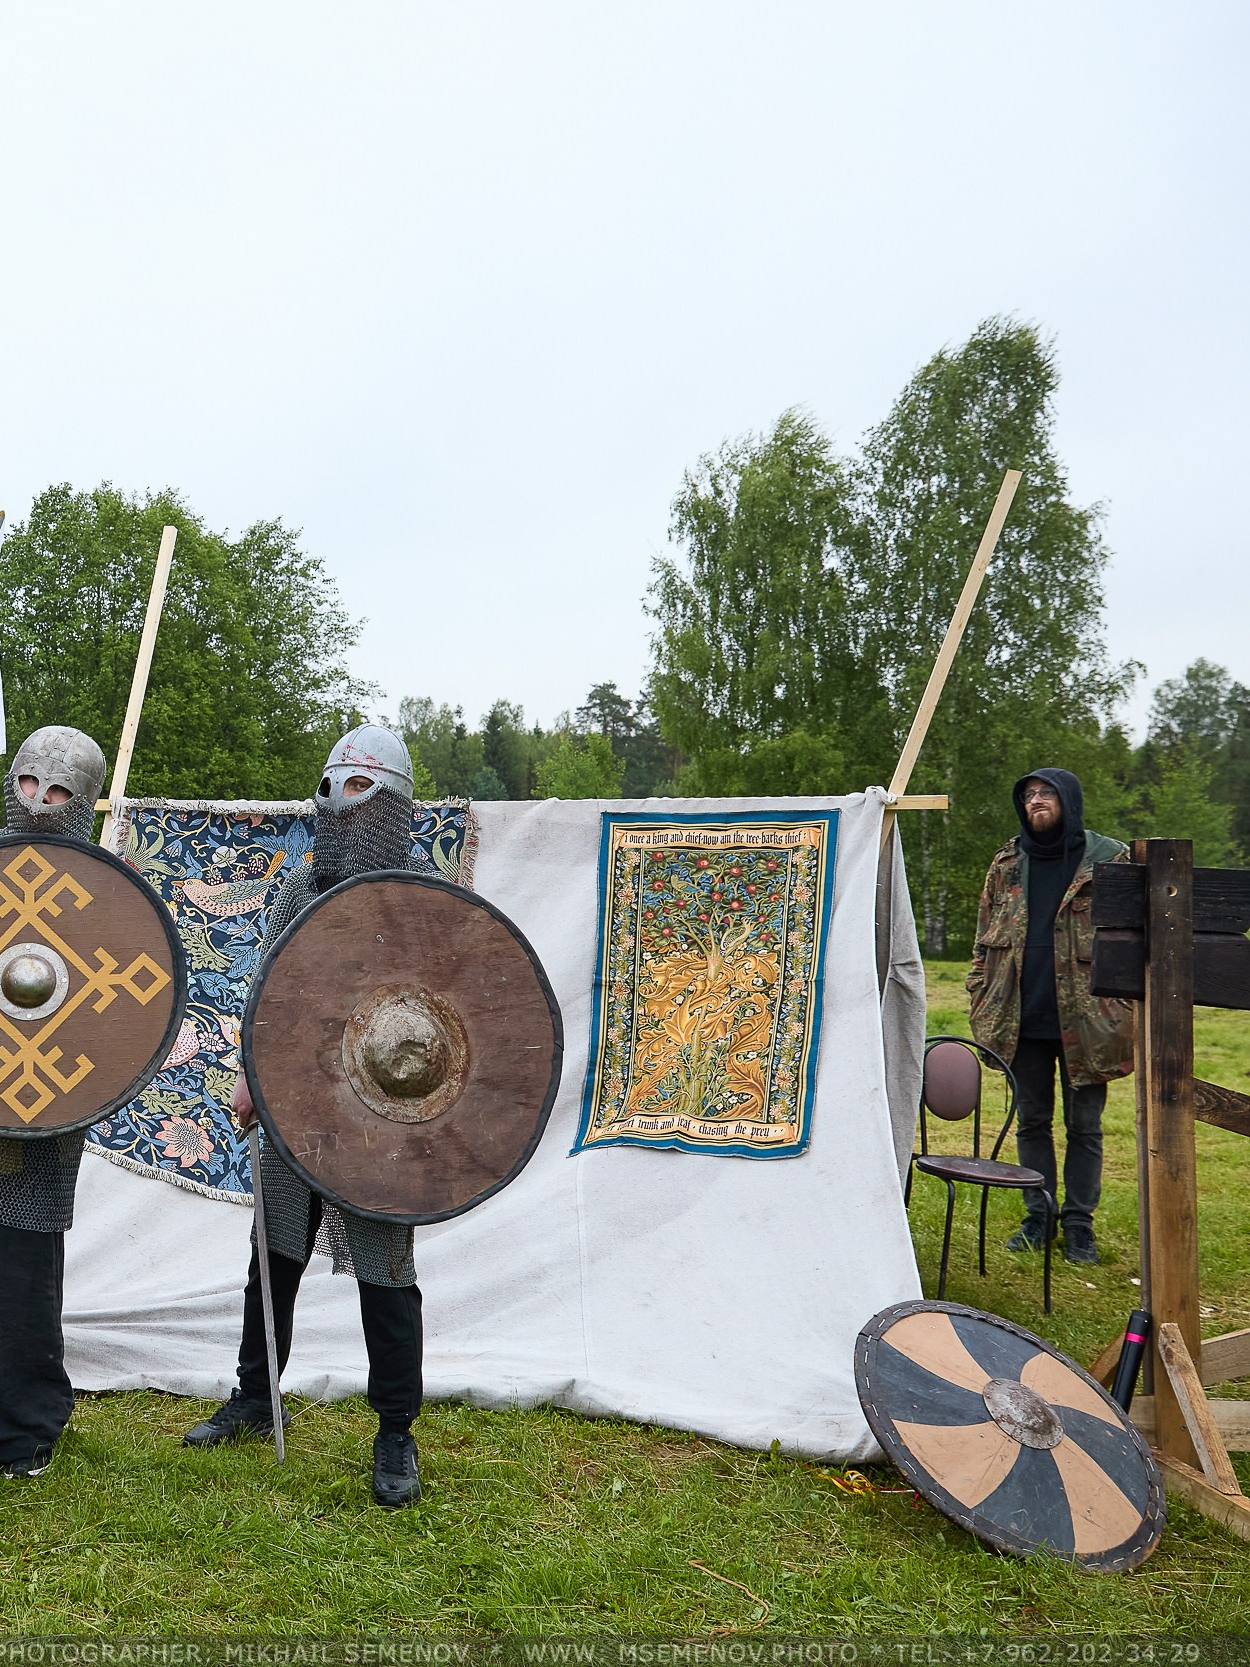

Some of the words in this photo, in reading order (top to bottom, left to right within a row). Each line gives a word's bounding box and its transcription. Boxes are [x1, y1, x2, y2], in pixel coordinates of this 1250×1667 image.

[629, 834, 645, 844] once
[646, 834, 651, 844] a
[652, 831, 669, 845] king
[670, 831, 683, 842] and
[720, 833, 731, 844] am
[733, 830, 744, 844] the
[638, 1119, 659, 1130] trunk
[660, 1117, 675, 1130] and
[677, 1116, 691, 1131] leaf
[699, 1123, 728, 1137] chasing
[734, 1121, 747, 1135] the
